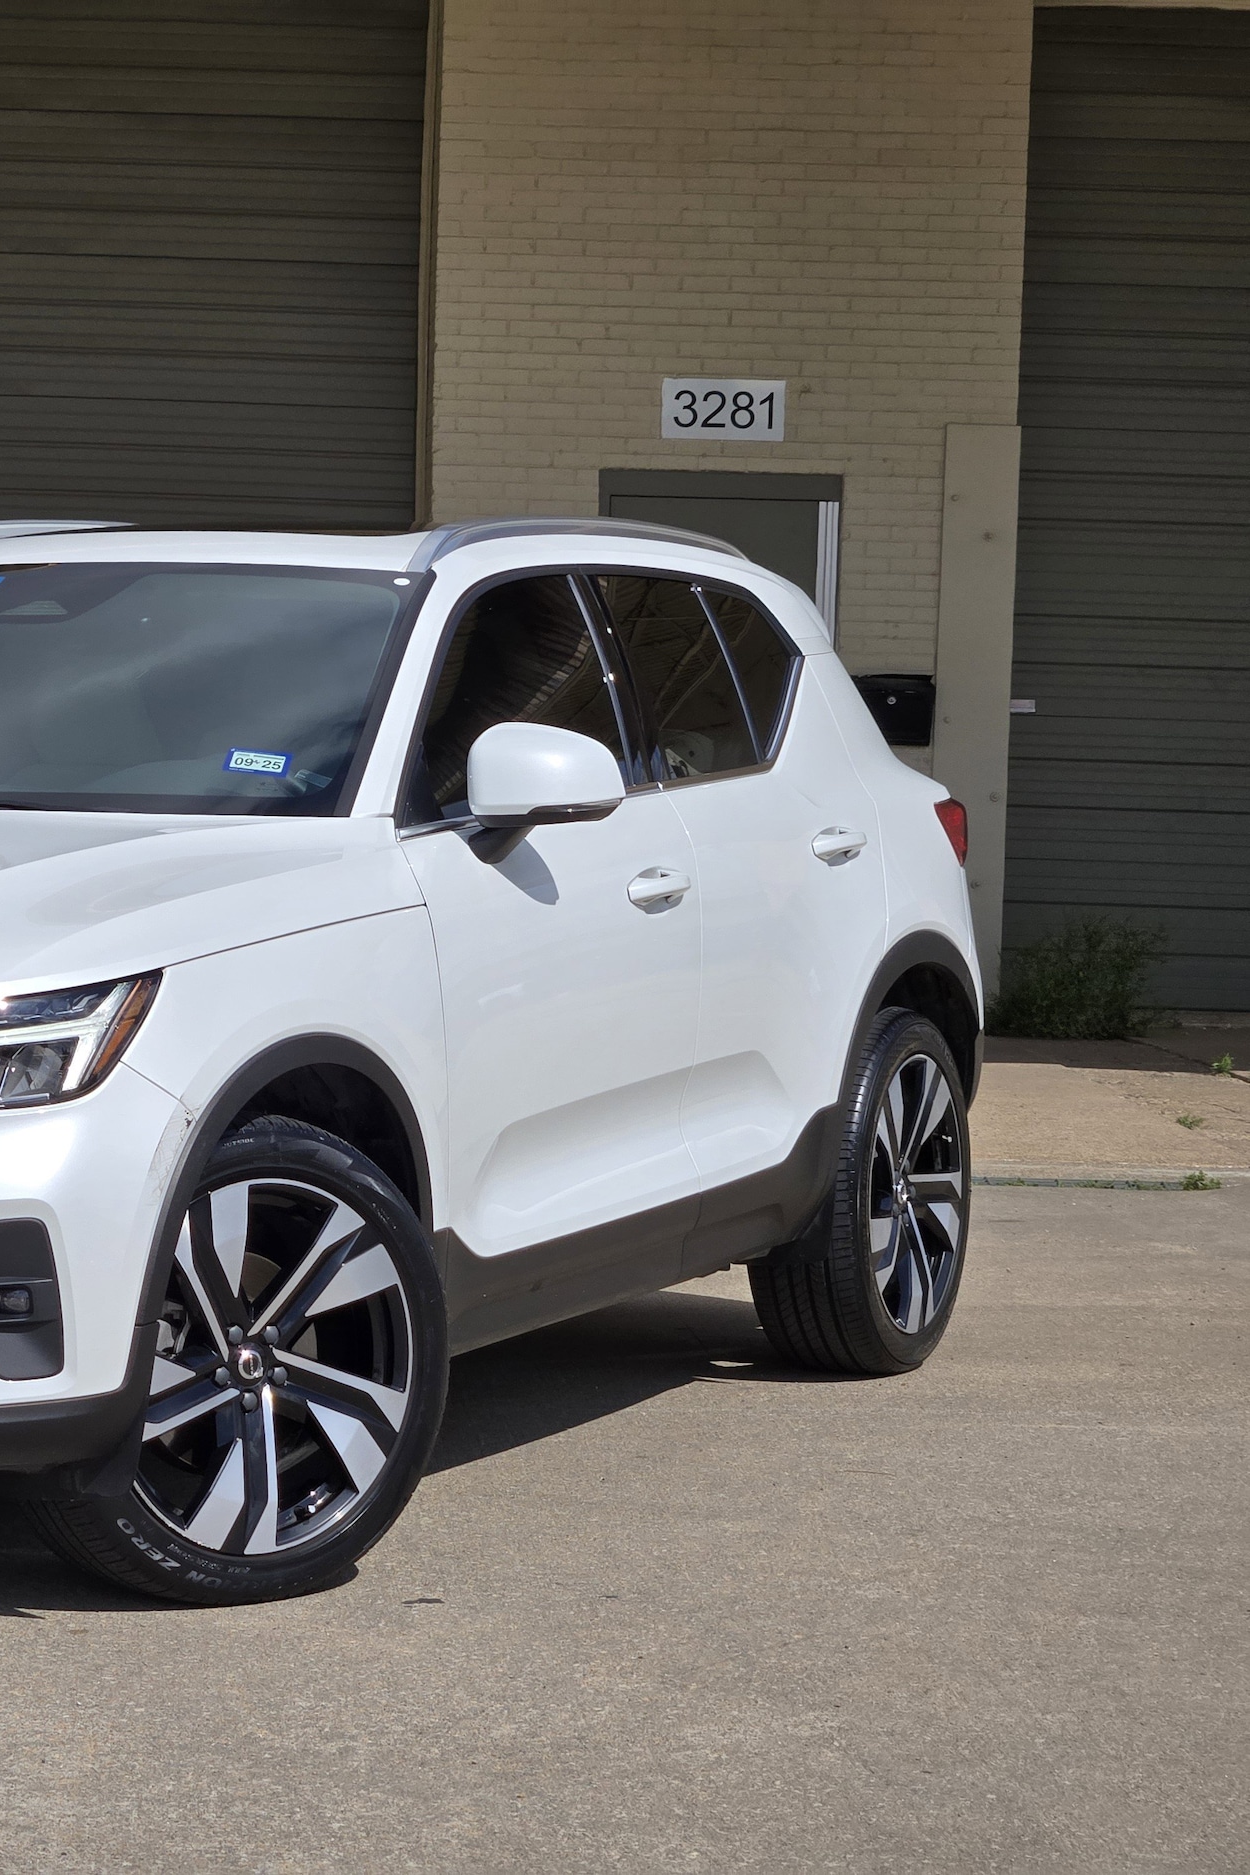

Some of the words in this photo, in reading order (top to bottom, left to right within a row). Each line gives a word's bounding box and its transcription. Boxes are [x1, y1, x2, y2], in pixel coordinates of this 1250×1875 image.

[673, 389, 775, 430] 3281
[234, 757, 254, 767] 09
[261, 760, 282, 770] 25
[116, 1518, 181, 1571] ZERO
